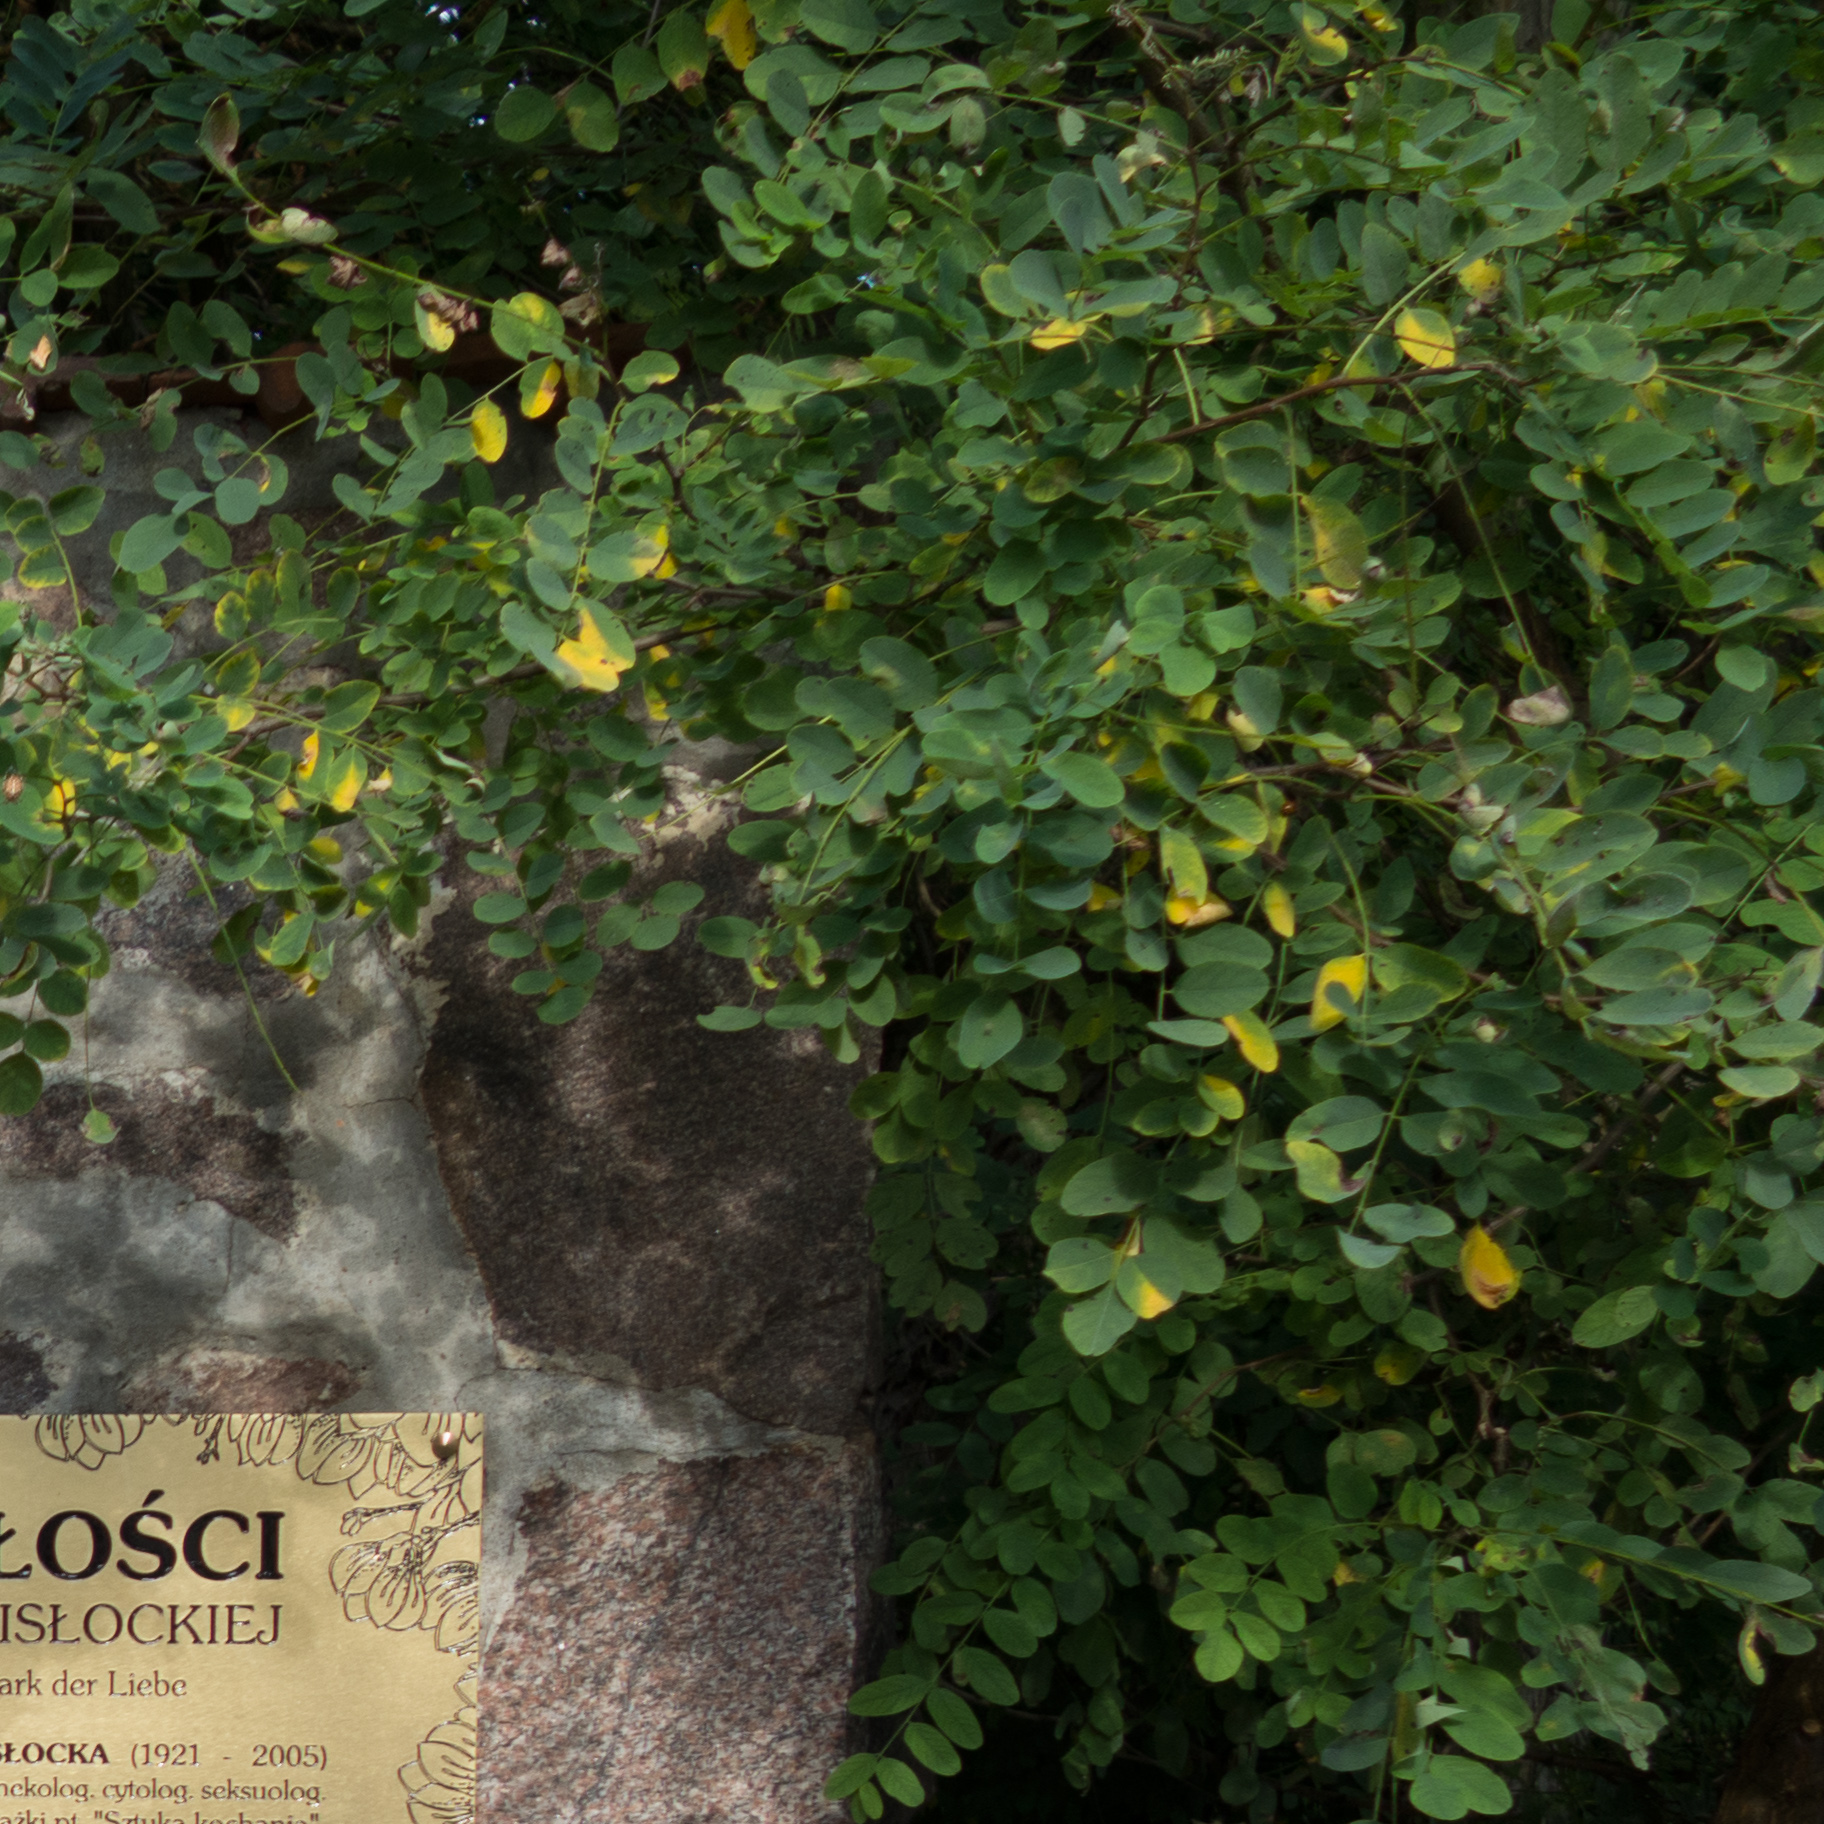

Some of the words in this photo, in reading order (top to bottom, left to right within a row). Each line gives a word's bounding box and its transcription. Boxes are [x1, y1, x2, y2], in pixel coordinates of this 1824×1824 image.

[52, 1669, 97, 1696] der
[108, 1670, 186, 1697] Liebe
[131, 1743, 197, 1769] (1921
[252, 1745, 326, 1771] 2005)
